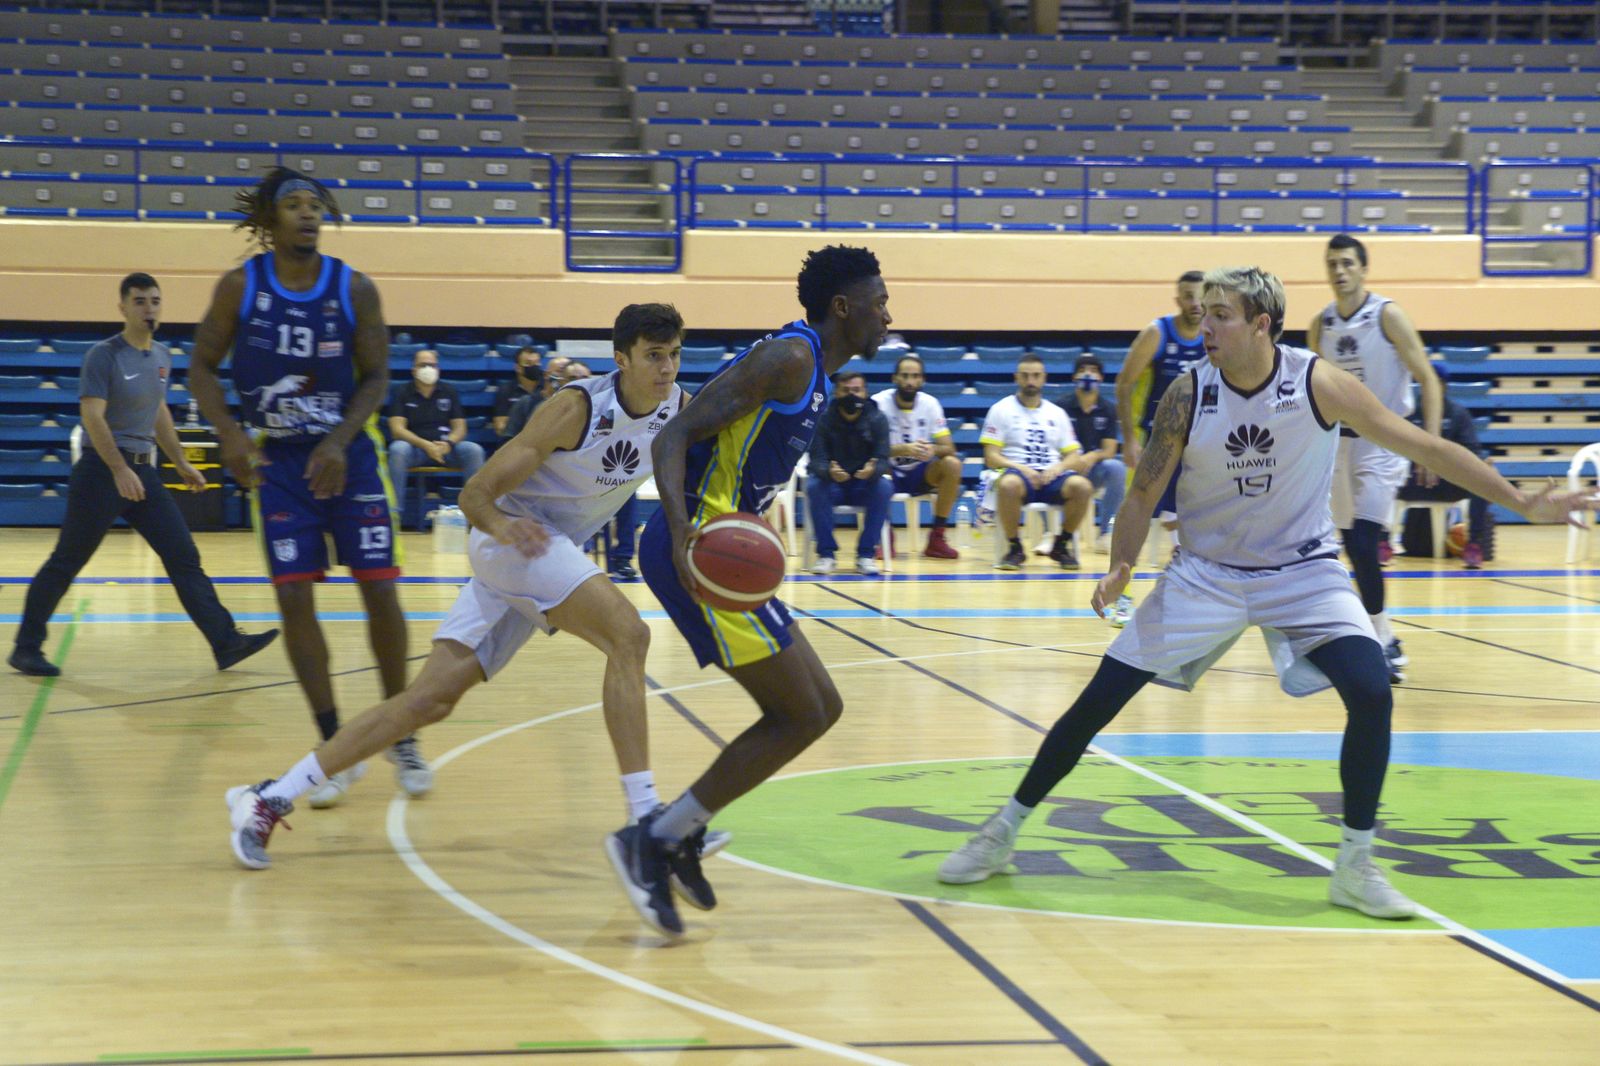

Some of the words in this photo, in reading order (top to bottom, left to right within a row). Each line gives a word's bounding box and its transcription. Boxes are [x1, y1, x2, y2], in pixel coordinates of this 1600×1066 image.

[276, 324, 314, 358] 13
[1226, 457, 1277, 470] HUAWEI
[595, 475, 634, 487] HUAW
[358, 525, 391, 550] 13
